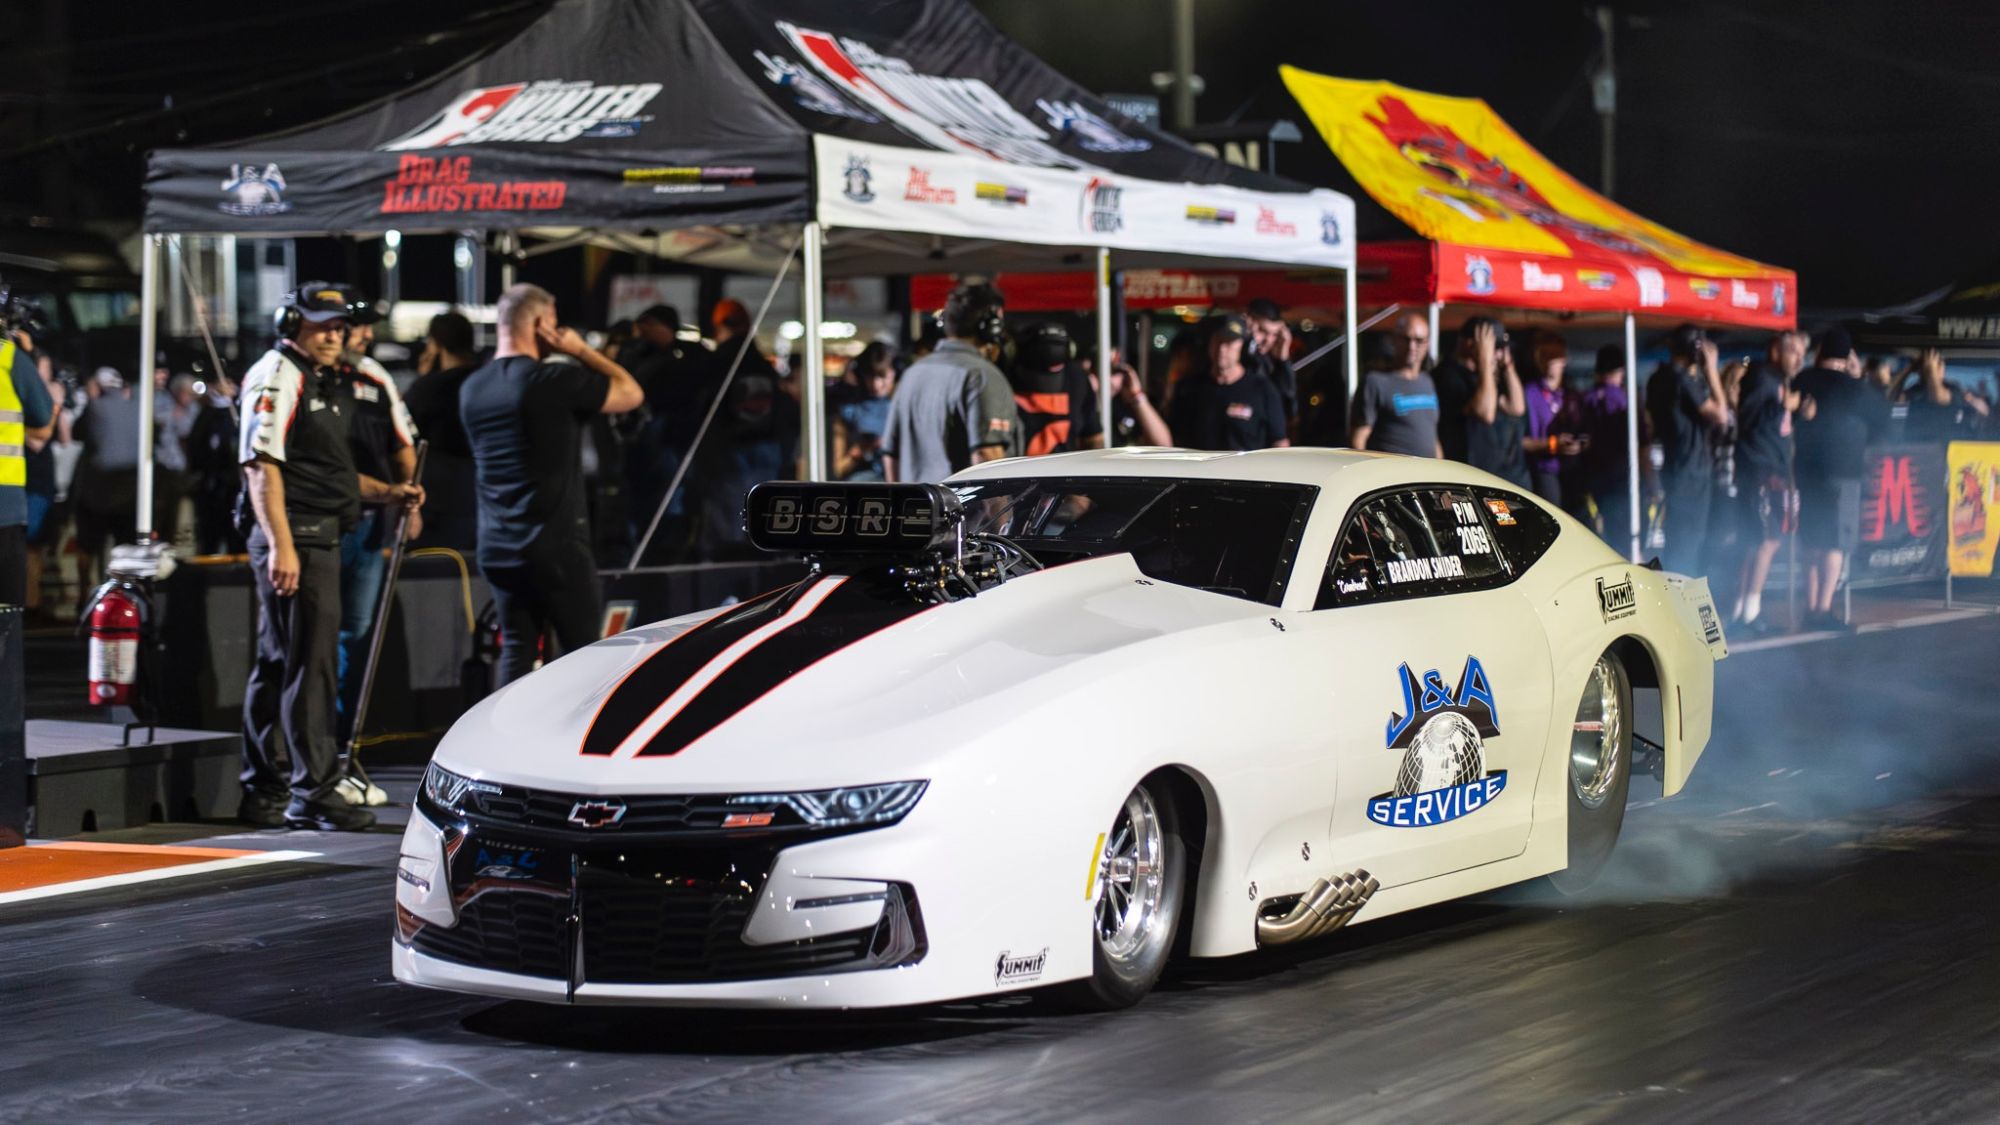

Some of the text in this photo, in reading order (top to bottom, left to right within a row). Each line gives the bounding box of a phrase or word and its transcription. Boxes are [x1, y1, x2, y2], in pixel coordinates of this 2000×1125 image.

[399, 154, 472, 184] DRAG
[381, 182, 567, 213] ILLUSTRATED
[1452, 501, 1478, 524] P/M
[1456, 526, 1491, 555] 2069
[1387, 555, 1464, 584] BRANDON SNIDER
[1386, 655, 1500, 749] J&A
[1372, 776, 1503, 826] SERVICE
[994, 946, 1049, 988] SUMMIT
